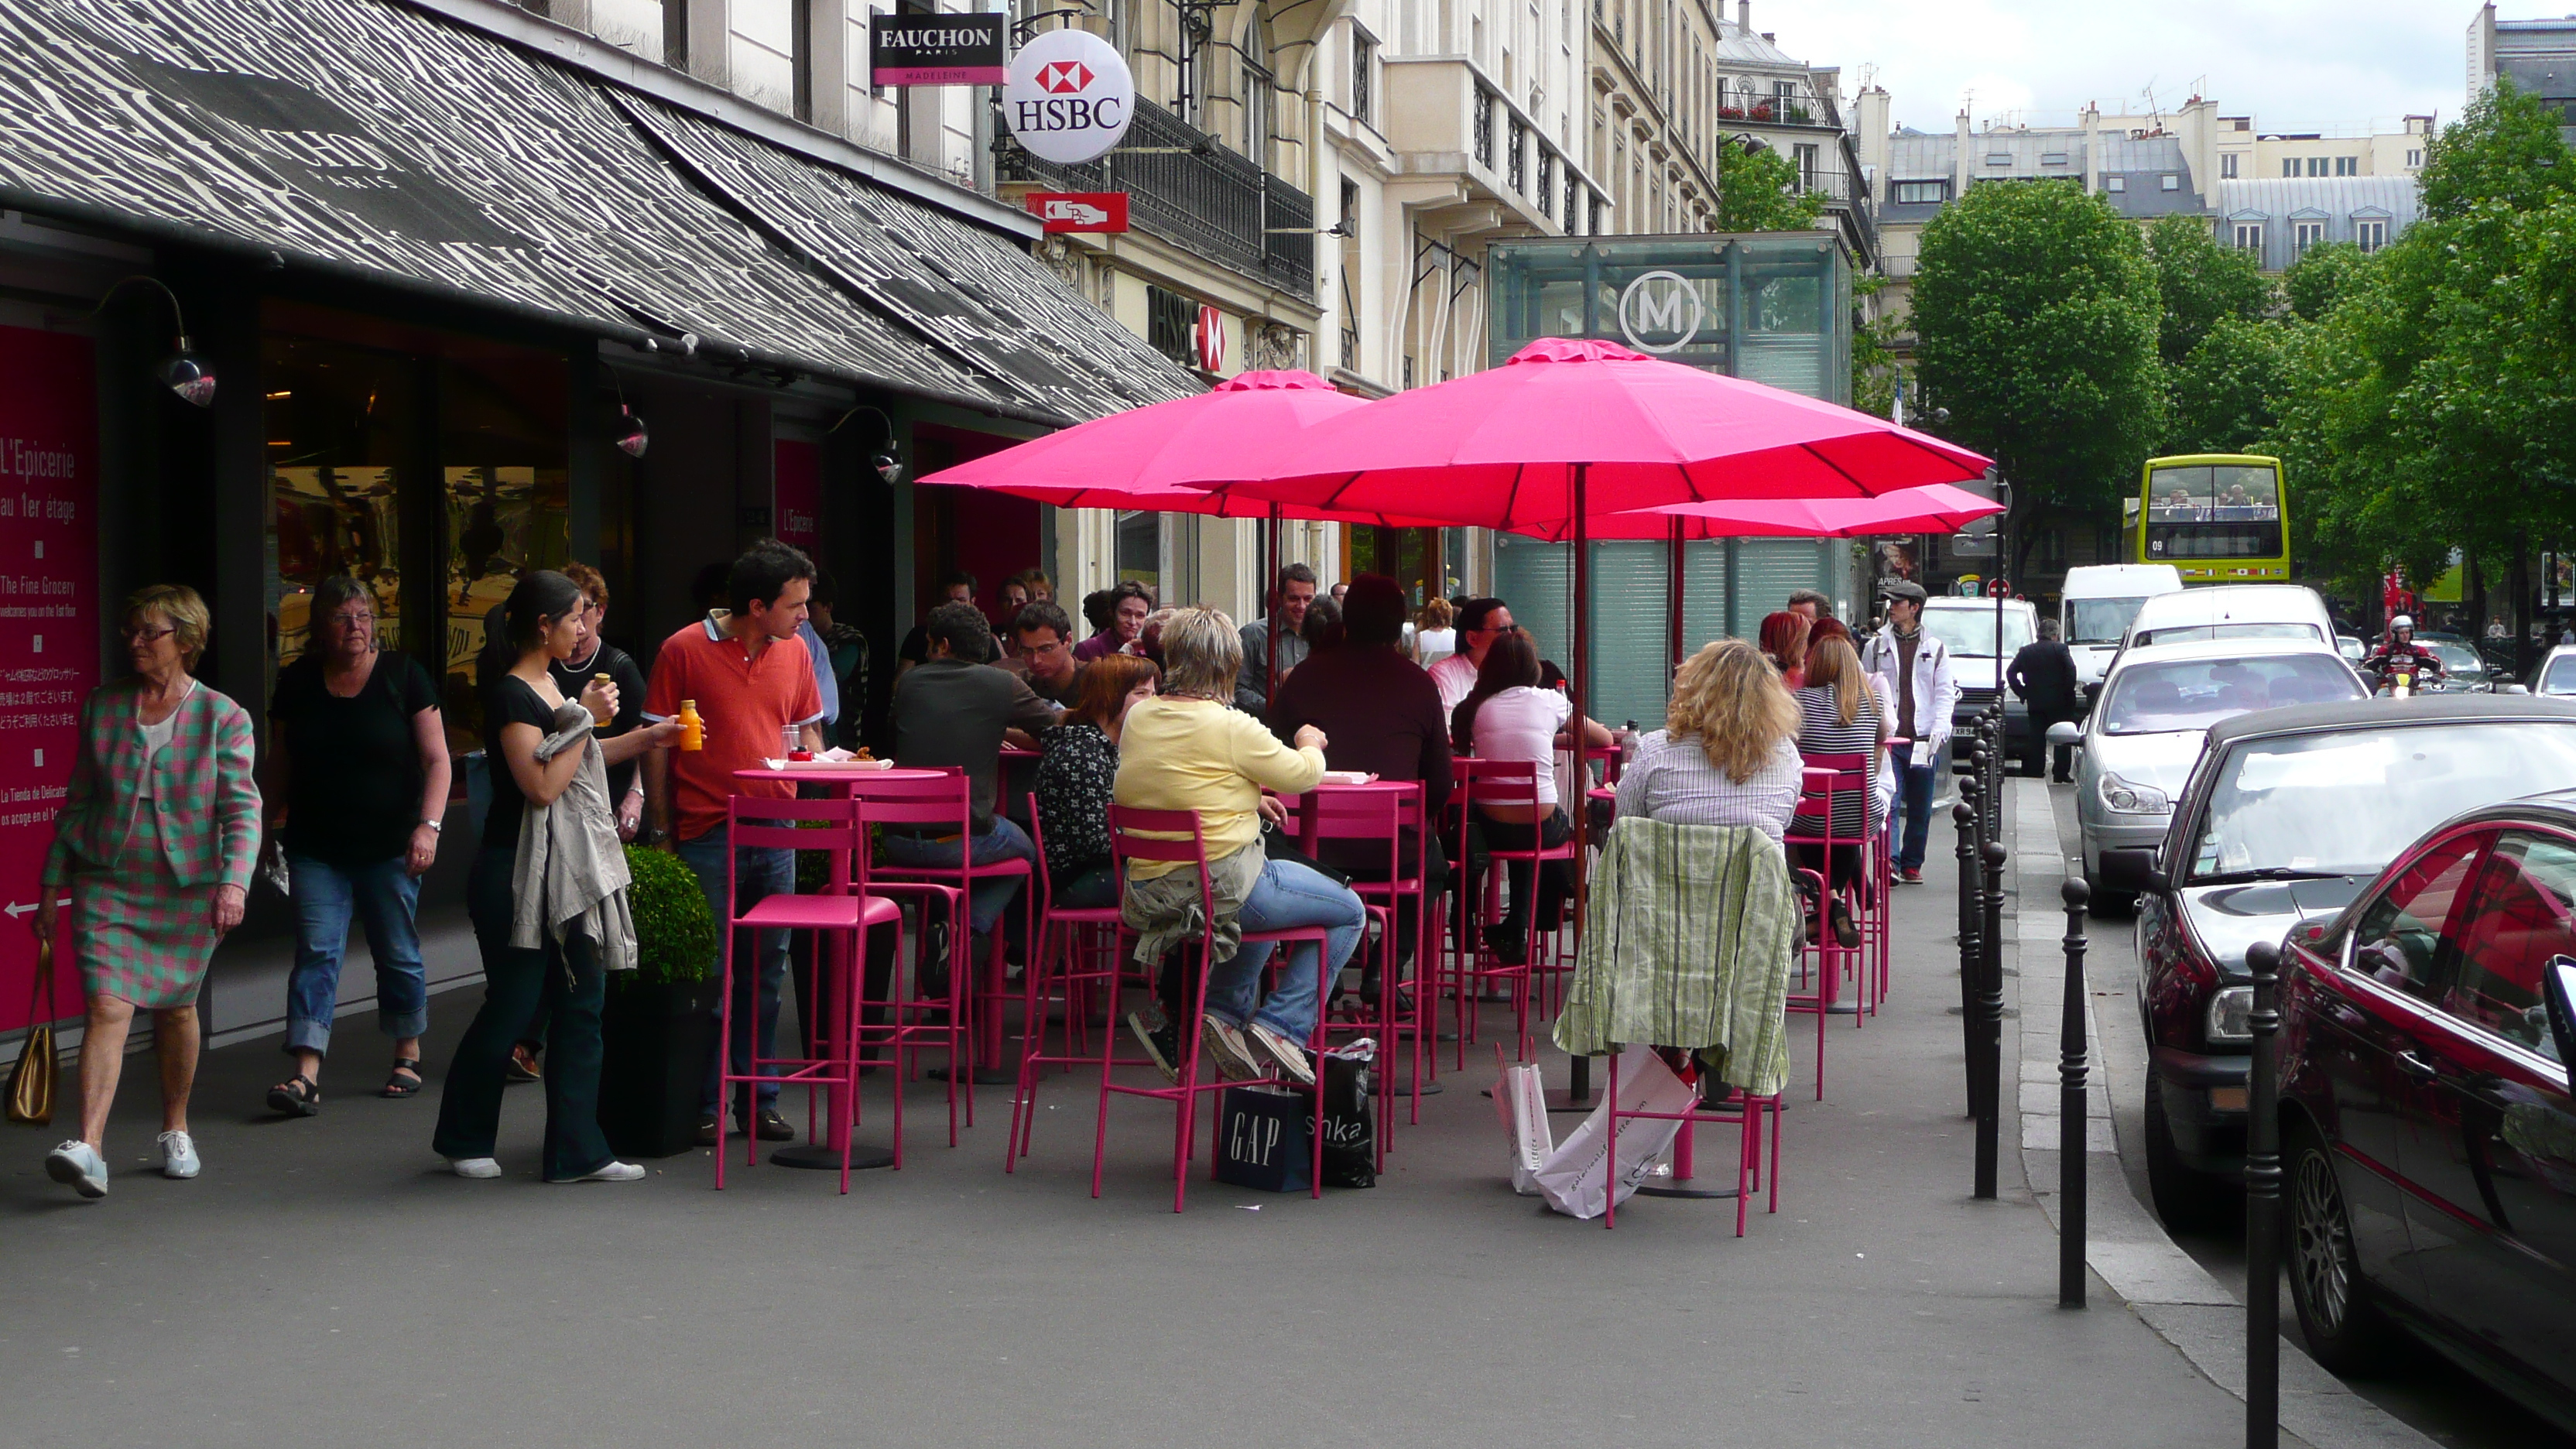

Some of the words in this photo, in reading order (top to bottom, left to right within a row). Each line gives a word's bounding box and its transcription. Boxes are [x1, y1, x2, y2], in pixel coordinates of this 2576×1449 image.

[880, 29, 992, 47] FAUCHON
[906, 71, 967, 80] MADELEINE
[1016, 97, 1121, 132] HSBC
[1146, 285, 1199, 366] HSBC
[1639, 289, 1681, 334] M
[0, 437, 74, 485] L'Epicerie
[1, 497, 14, 516] au
[22, 492, 40, 518] 1er
[46, 493, 75, 525] étage
[2153, 540, 2163, 550] 09
[0, 575, 17, 594] The
[20, 575, 39, 594] Fine
[43, 576, 75, 598] Grocery
[1, 789, 9, 803] La
[10, 787, 31, 802] Tienda
[33, 786, 39, 800] de
[2, 814, 9, 826] os
[12, 812, 31, 827] acoge
[33, 811, 41, 822] en
[43, 807, 49, 821] el
[1231, 1112, 1279, 1166] GAP
